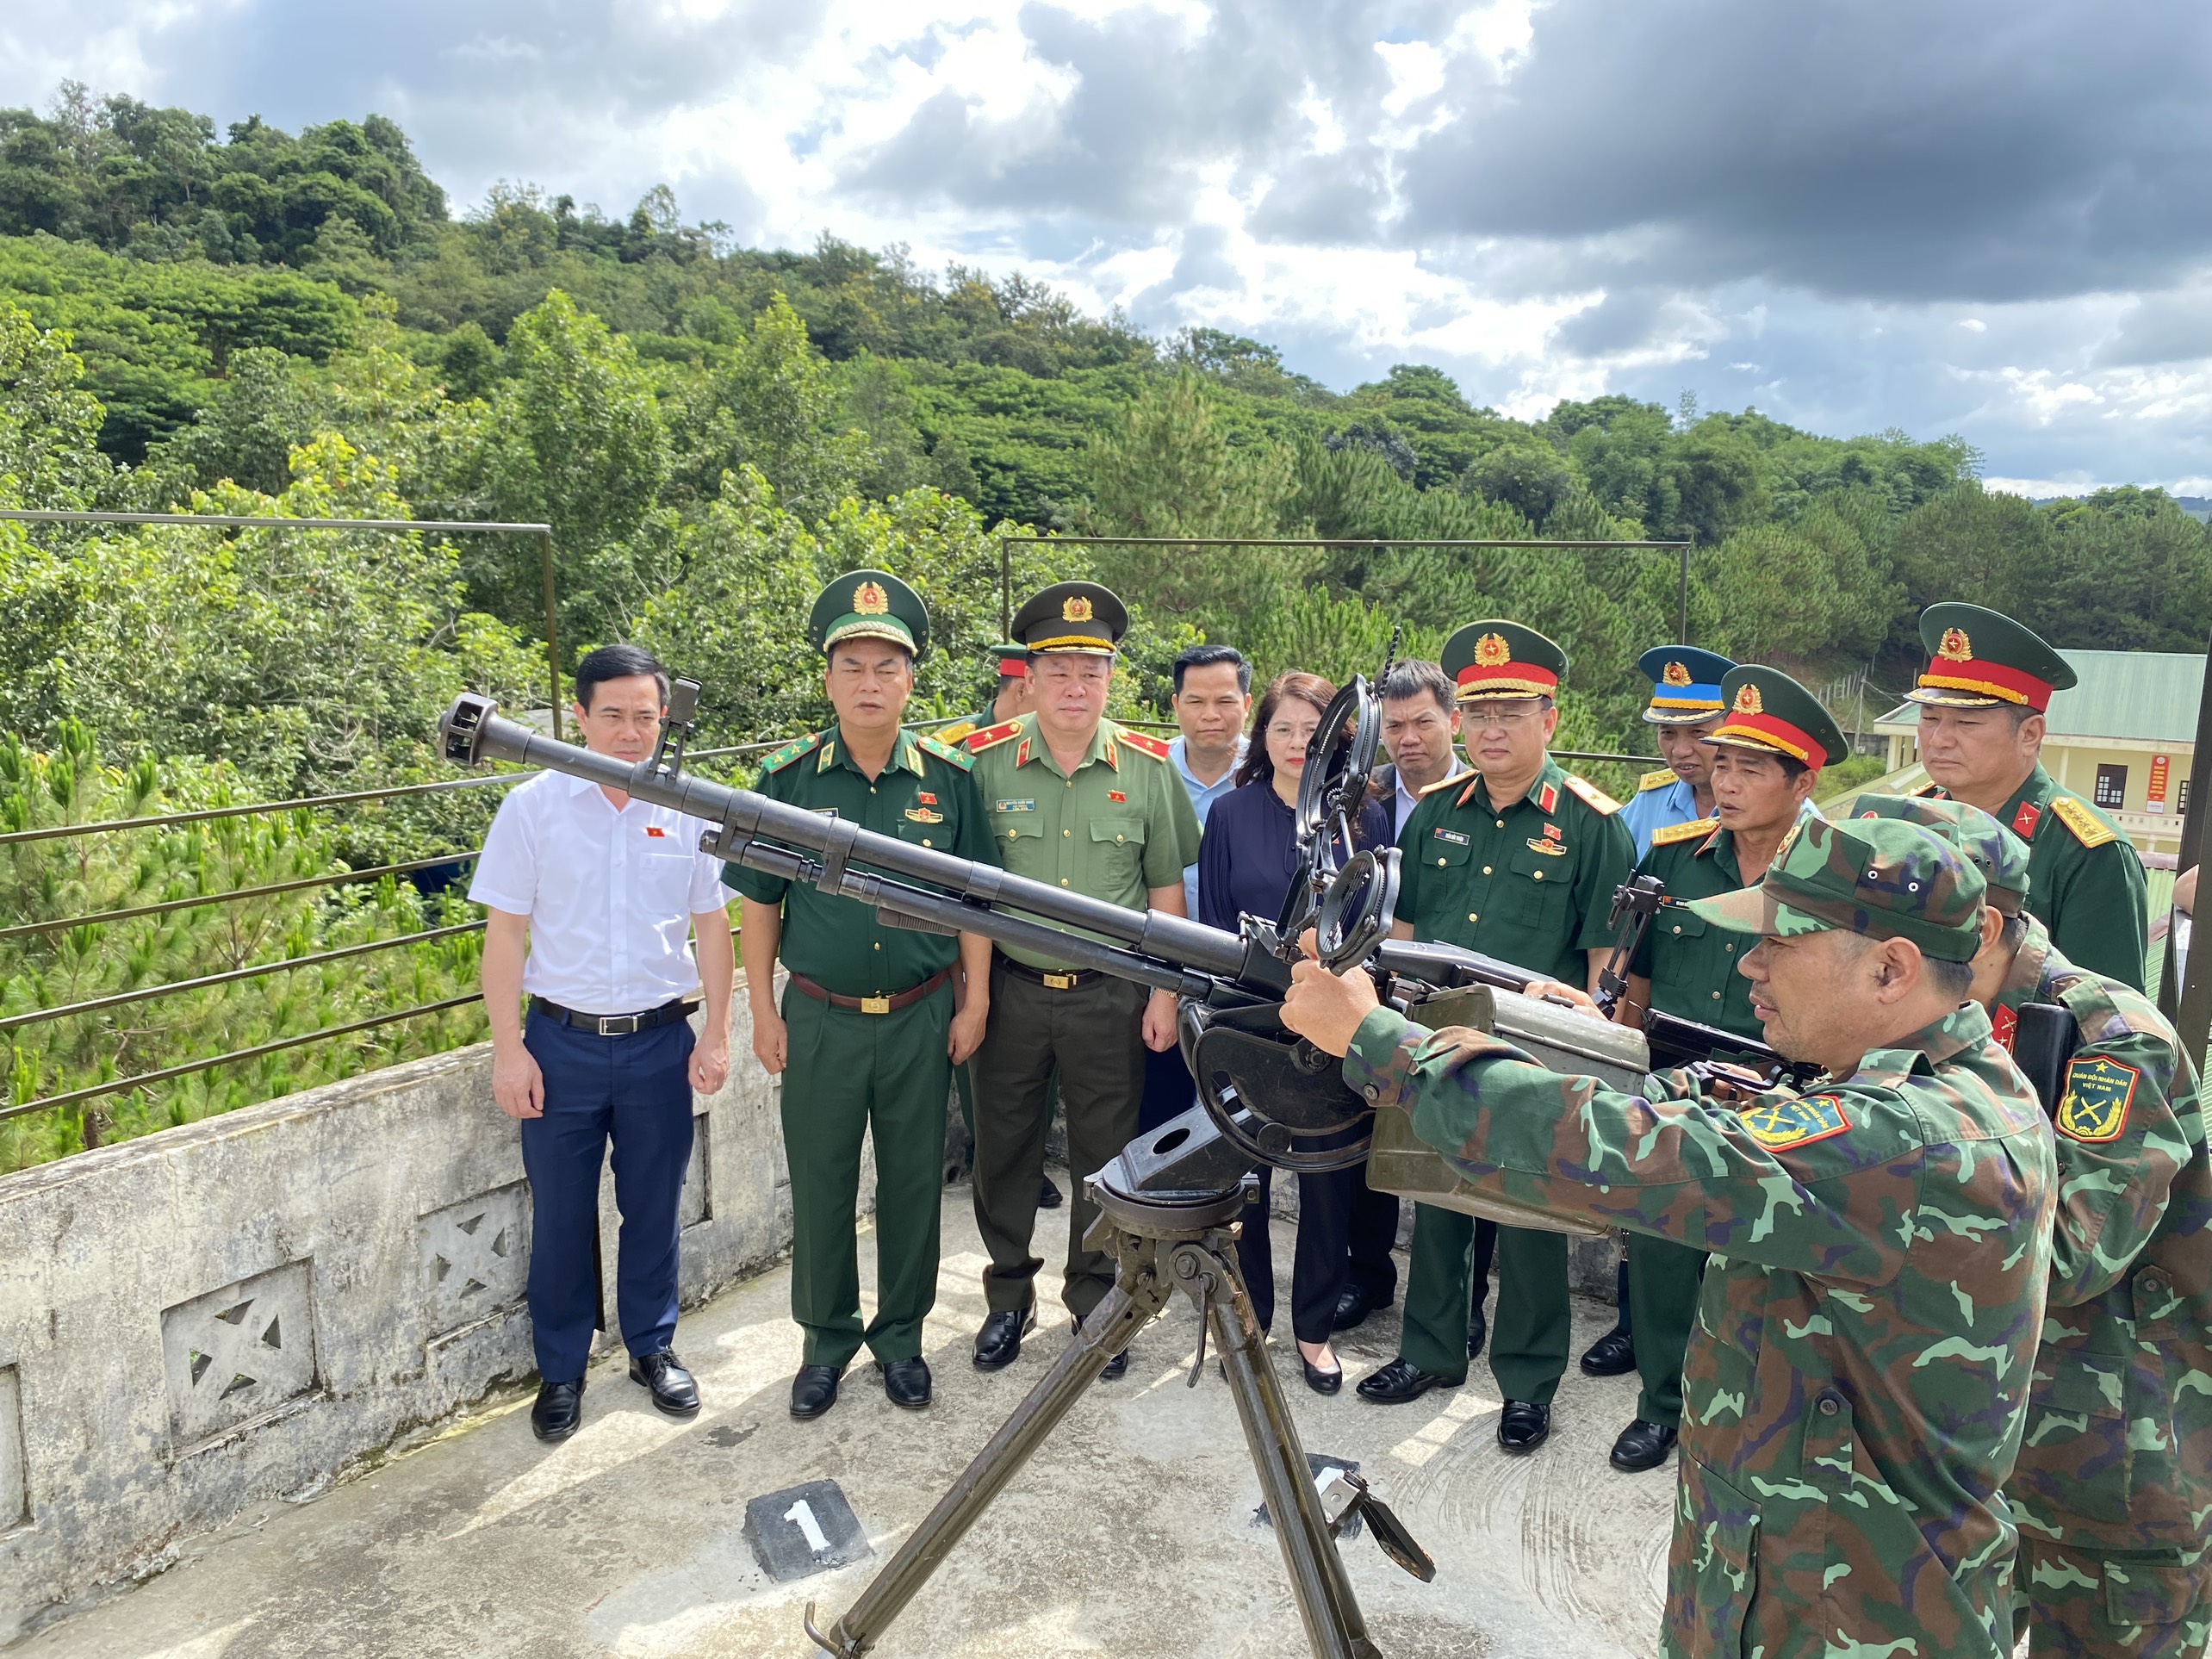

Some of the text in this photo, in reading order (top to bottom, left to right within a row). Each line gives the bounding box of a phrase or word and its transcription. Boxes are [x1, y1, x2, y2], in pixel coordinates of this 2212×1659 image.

[2087, 1073, 2098, 1082] ĐỘI
[2097, 1076, 2115, 1084] NHÂN
[2115, 1078, 2128, 1087] DÂN
[783, 1499, 831, 1552] 1
